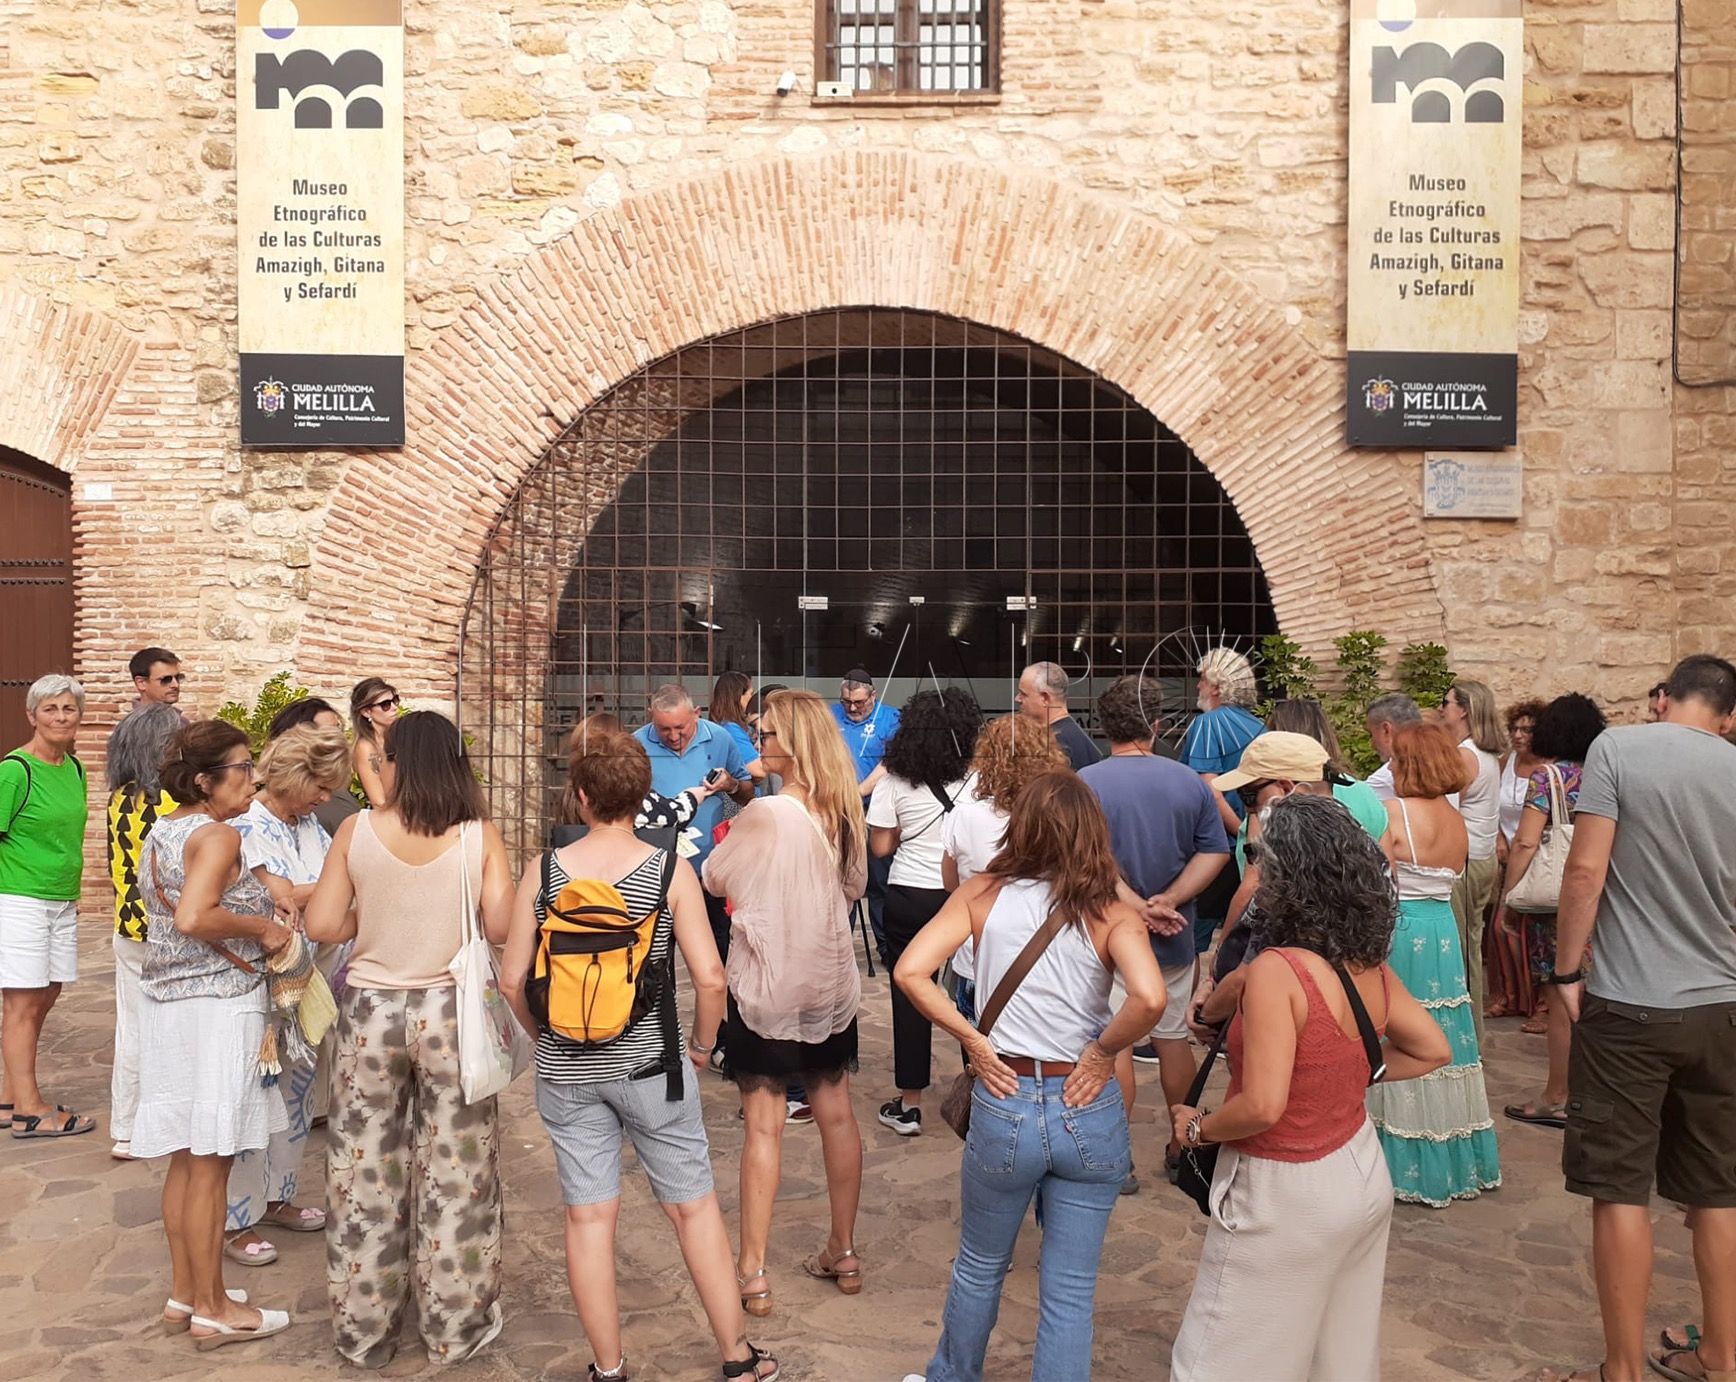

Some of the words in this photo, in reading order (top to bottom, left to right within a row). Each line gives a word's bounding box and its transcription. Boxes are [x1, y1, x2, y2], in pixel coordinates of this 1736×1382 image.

[293, 180, 348, 196] Museo
[1409, 174, 1466, 192] Museo
[273, 205, 367, 225] Etnográfico
[1389, 200, 1486, 220] Etnográfico
[259, 232, 278, 248] de
[284, 231, 307, 248] las
[313, 231, 382, 248] Culturas
[1374, 227, 1393, 244] de
[1399, 227, 1423, 244] las
[1429, 227, 1501, 244] Culturas
[256, 256, 328, 278] Amazigh,
[333, 256, 385, 274] Gitana
[1370, 253, 1444, 275] Amazigh,
[1451, 253, 1504, 271] Gitana
[284, 287, 292, 303] y
[298, 282, 357, 299] Sefardí
[1398, 285, 1408, 300] y
[1413, 280, 1475, 297] Sefardí
[291, 383, 323, 392] CIUDAD
[324, 383, 375, 393] AUTÓNOMA
[1401, 382, 1434, 391] CIUDAD
[1435, 382, 1487, 392] AUTÓNOMA
[293, 393, 376, 412] MELILLA
[1403, 391, 1488, 411] MELILLA
